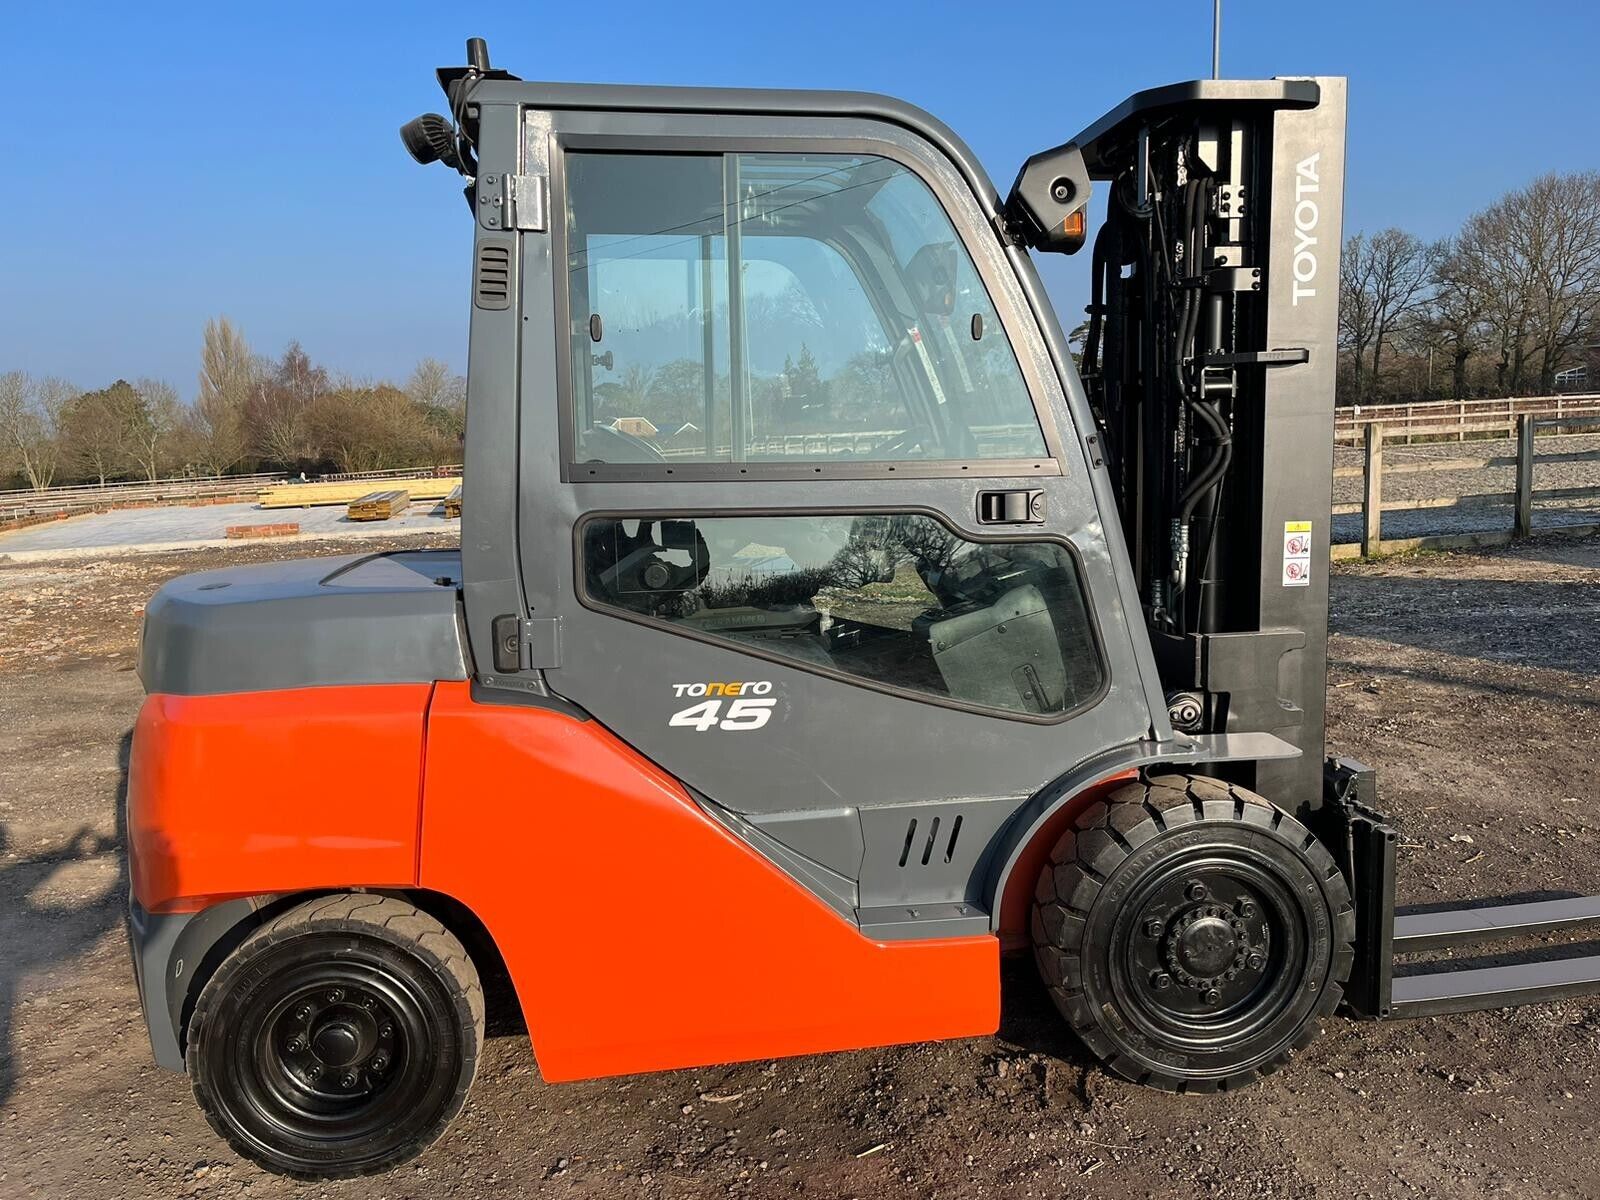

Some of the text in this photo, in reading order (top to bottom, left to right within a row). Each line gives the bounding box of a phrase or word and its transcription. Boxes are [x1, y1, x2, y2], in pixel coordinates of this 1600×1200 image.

[1292, 152, 1320, 306] TOYOTA
[672, 681, 773, 698] TONERO
[668, 698, 777, 731] 45
